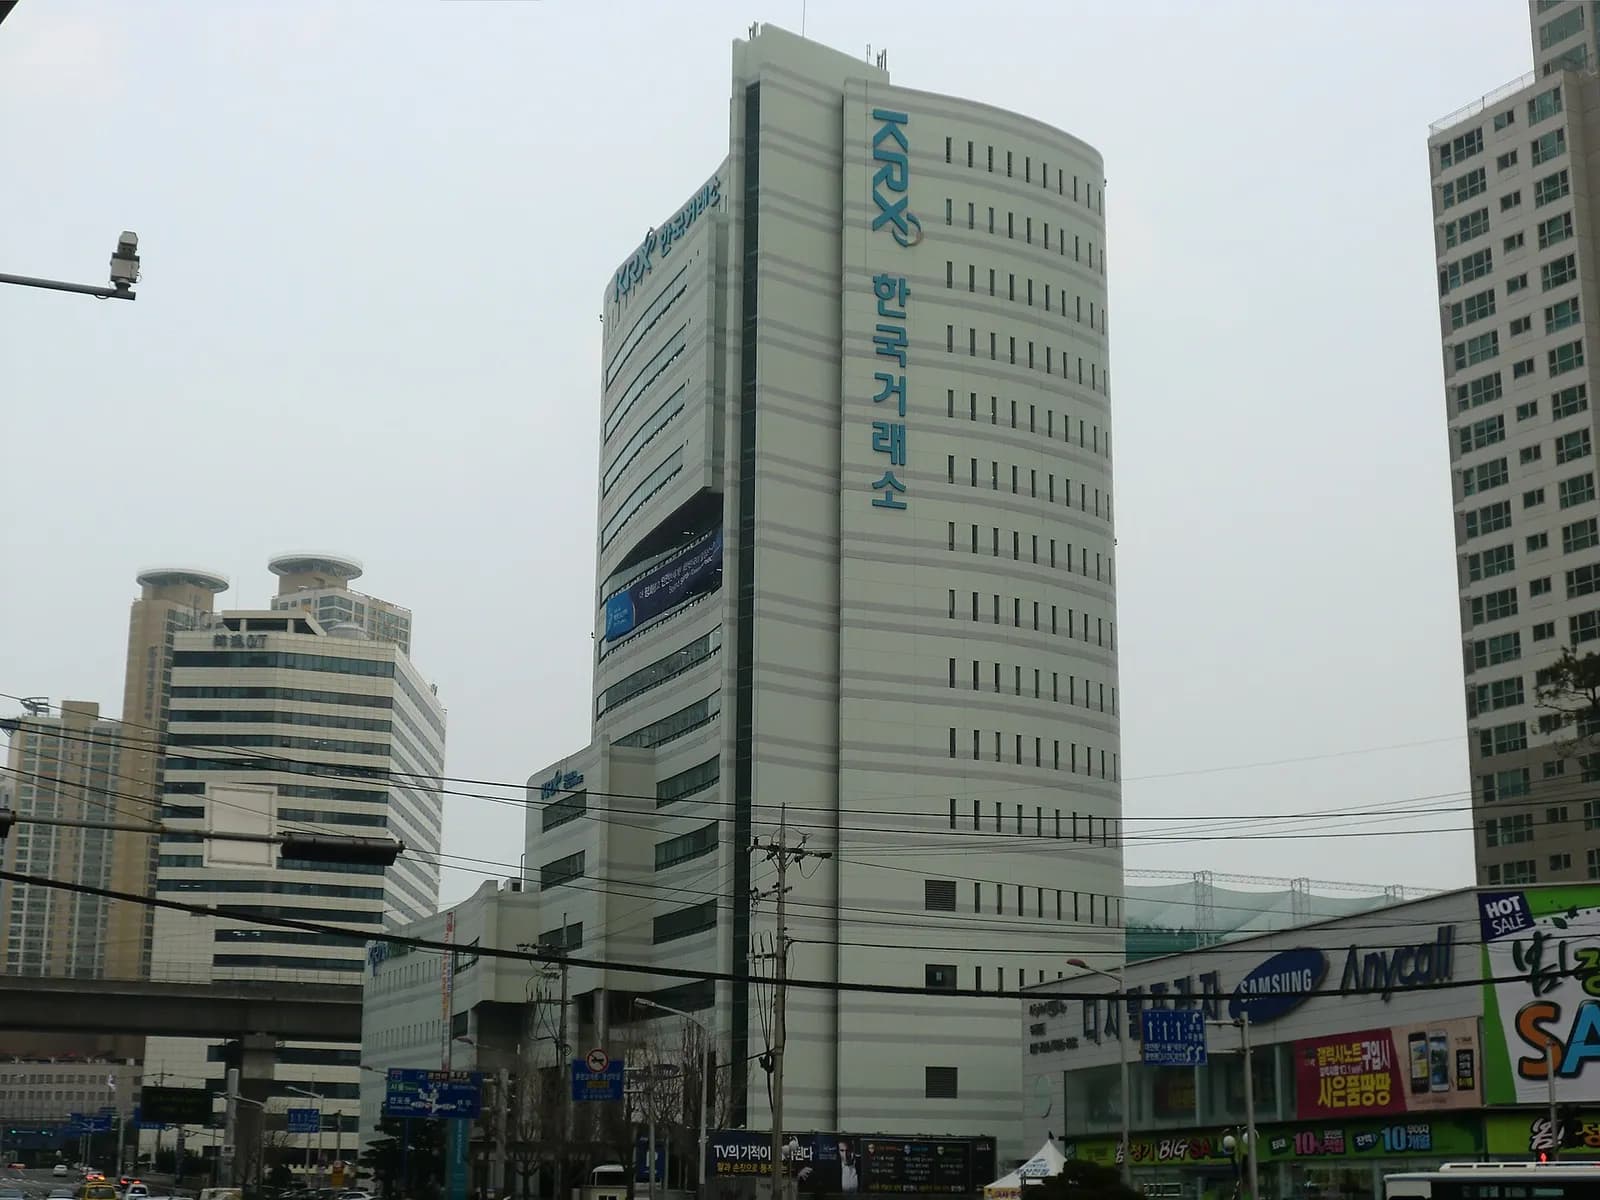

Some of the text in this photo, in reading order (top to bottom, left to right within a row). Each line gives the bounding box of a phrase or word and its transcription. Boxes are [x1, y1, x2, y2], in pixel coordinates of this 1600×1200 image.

[872, 108, 917, 241] KRX
[872, 272, 911, 511] 한국거래소
[1484, 895, 1522, 919] HOT
[1491, 911, 1527, 935] SALE
[1340, 924, 1455, 1003] Anycall
[1239, 967, 1312, 1004] SAMSUNG
[713, 1144, 738, 1160] TV의
[741, 1145, 771, 1161] 기적이
[1159, 1139, 1188, 1160] BIG
